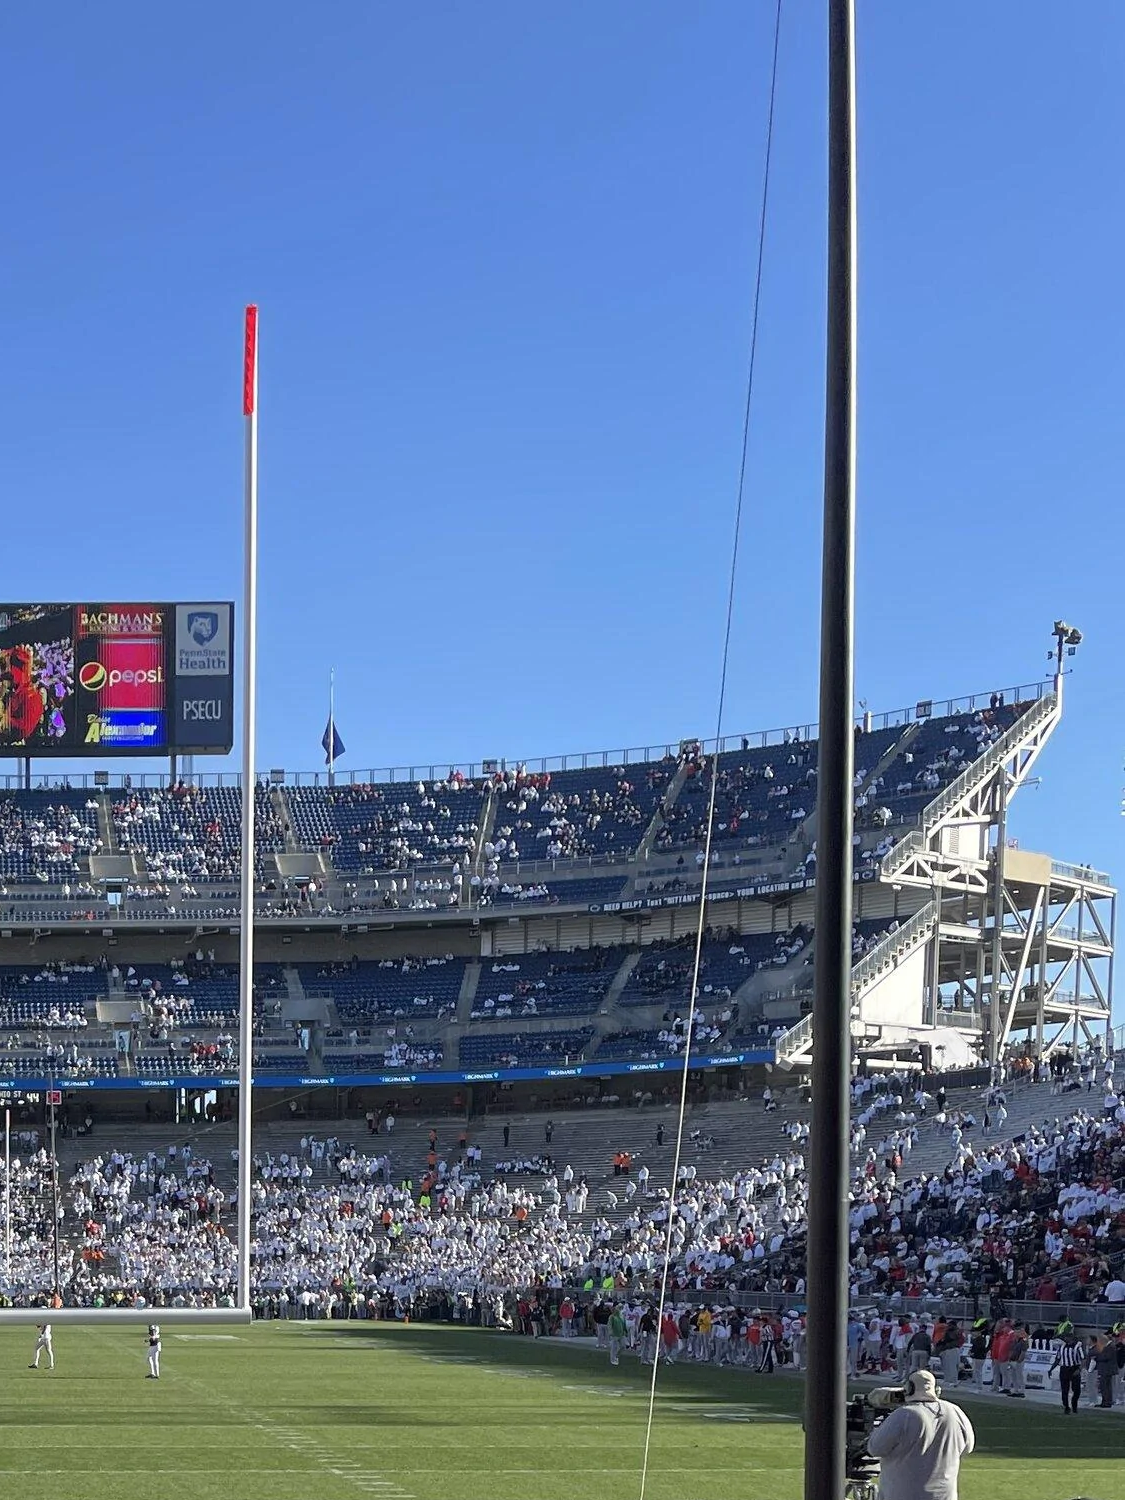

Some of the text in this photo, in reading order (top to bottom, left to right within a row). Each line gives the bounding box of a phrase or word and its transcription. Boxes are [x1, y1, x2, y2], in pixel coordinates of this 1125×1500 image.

[179, 657, 225, 670] Health
[109, 665, 165, 687] pepsi
[182, 700, 223, 720] PSECU
[737, 887, 755, 897] YOUR
[757, 881, 790, 894] LOCATION
[13, 1090, 22, 1098] ST
[26, 1092, 40, 1103] 44
